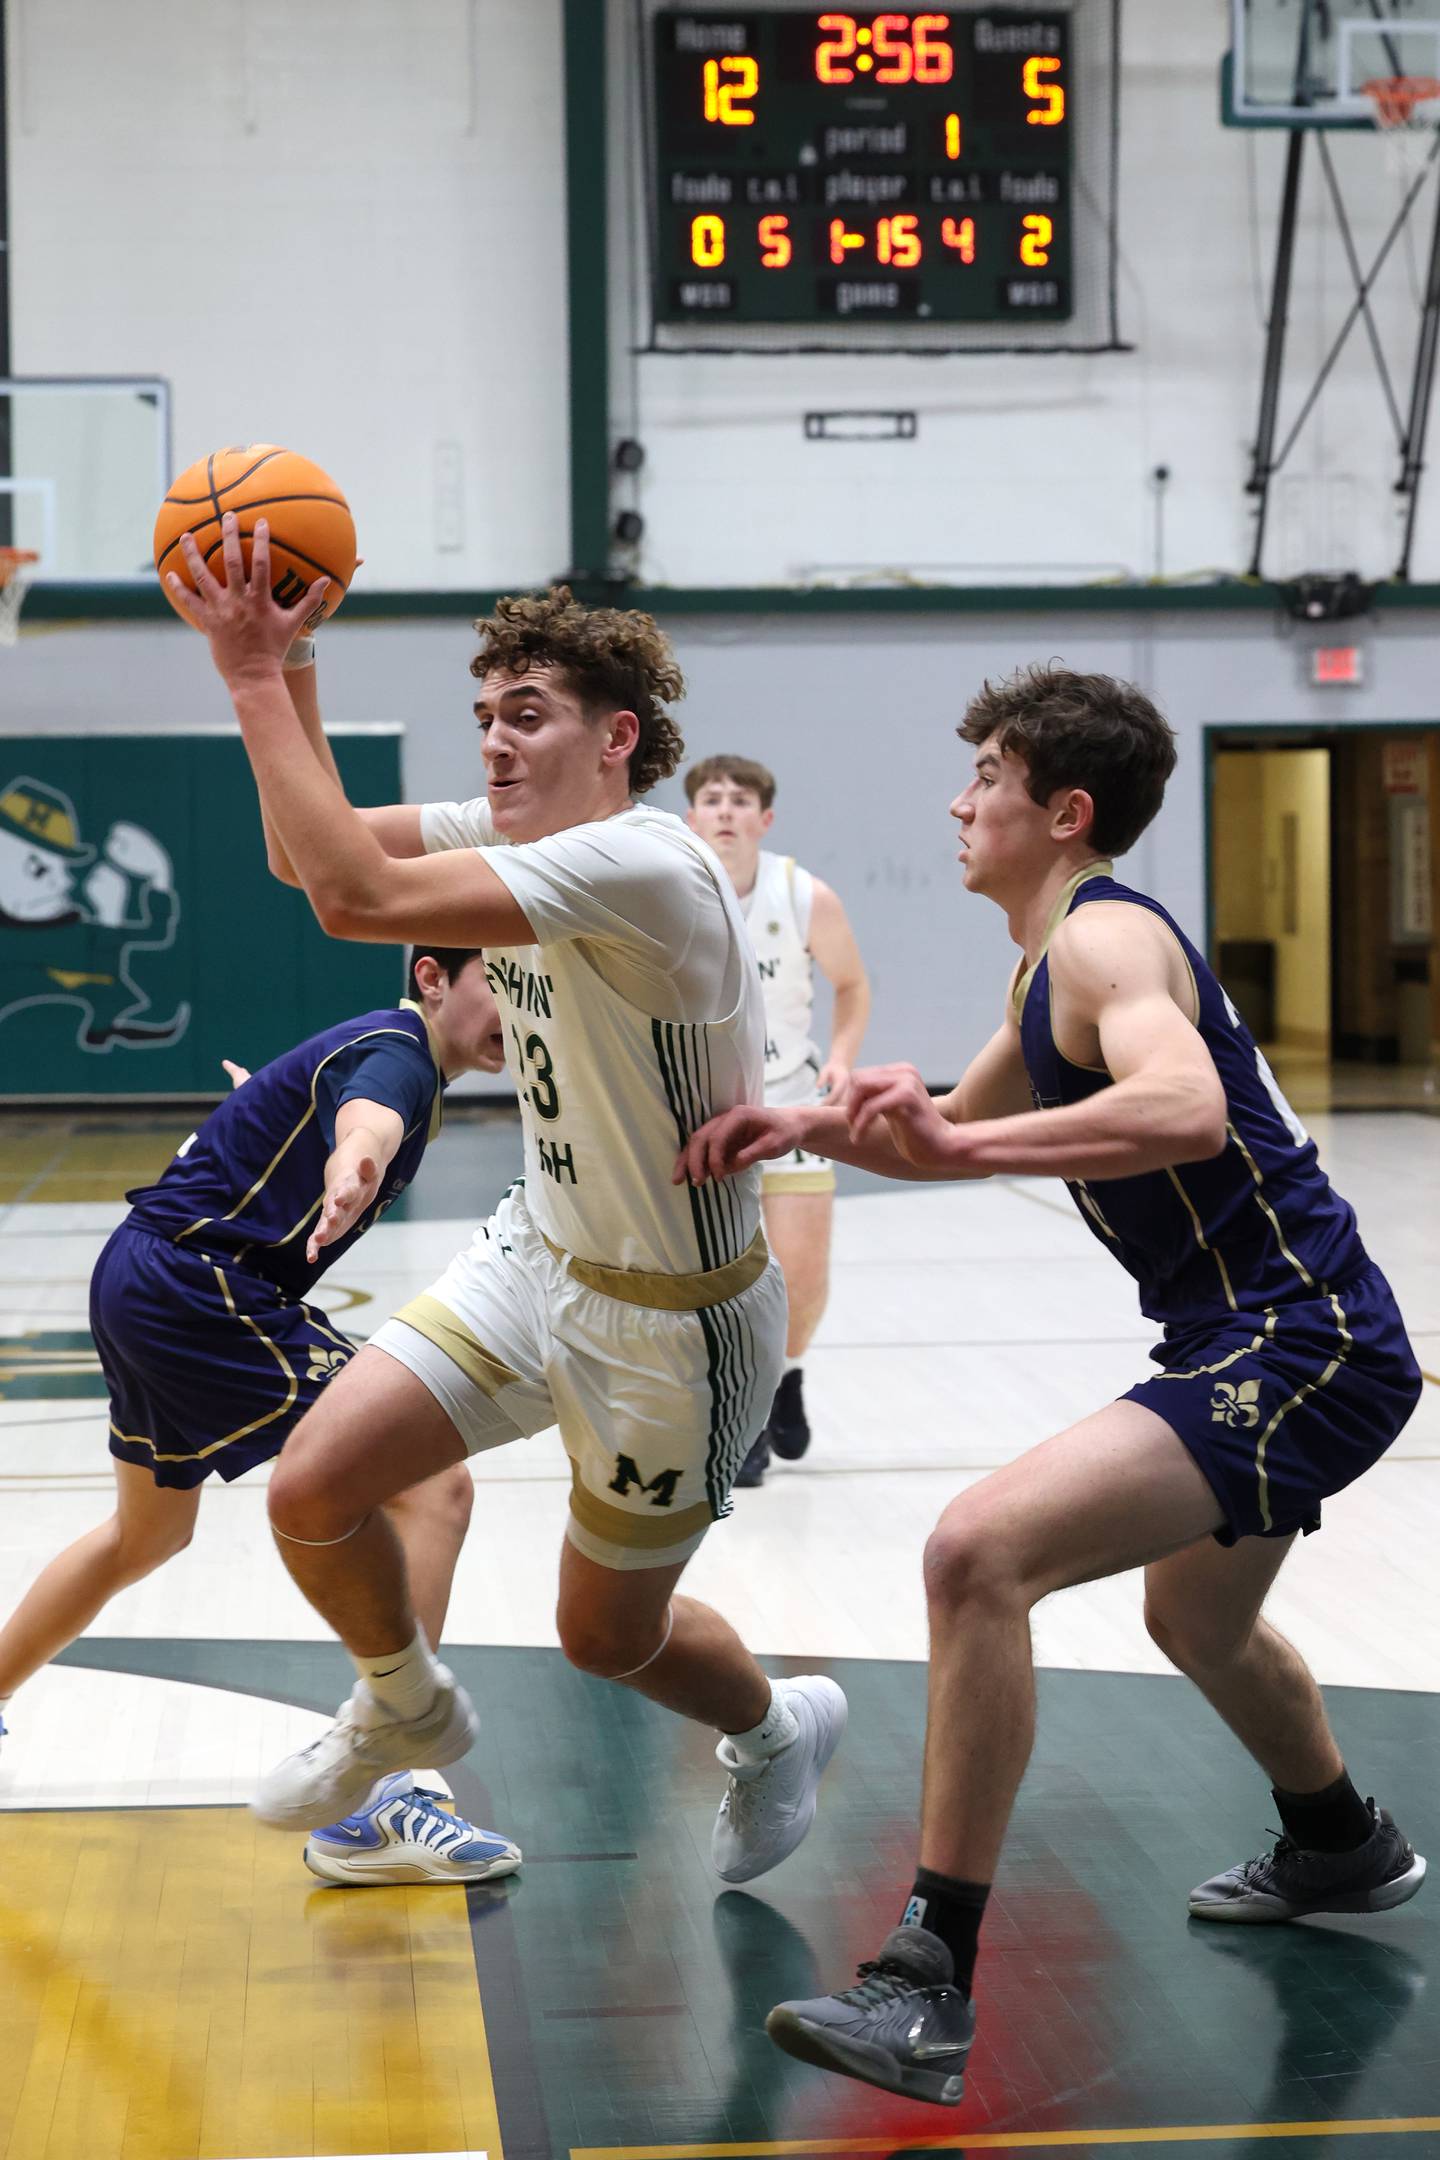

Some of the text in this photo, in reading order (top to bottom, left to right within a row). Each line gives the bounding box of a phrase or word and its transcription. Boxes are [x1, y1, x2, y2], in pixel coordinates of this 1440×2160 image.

[815, 14, 954, 84] 2:56
[703, 56, 759, 125] 12
[1022, 56, 1065, 125] 5
[945, 113, 961, 160] 1
[691, 214, 725, 268] 0
[758, 214, 792, 269] 5
[941, 217, 975, 265] 4
[1020, 214, 1053, 268] 2
[607, 1452, 685, 1507] M
